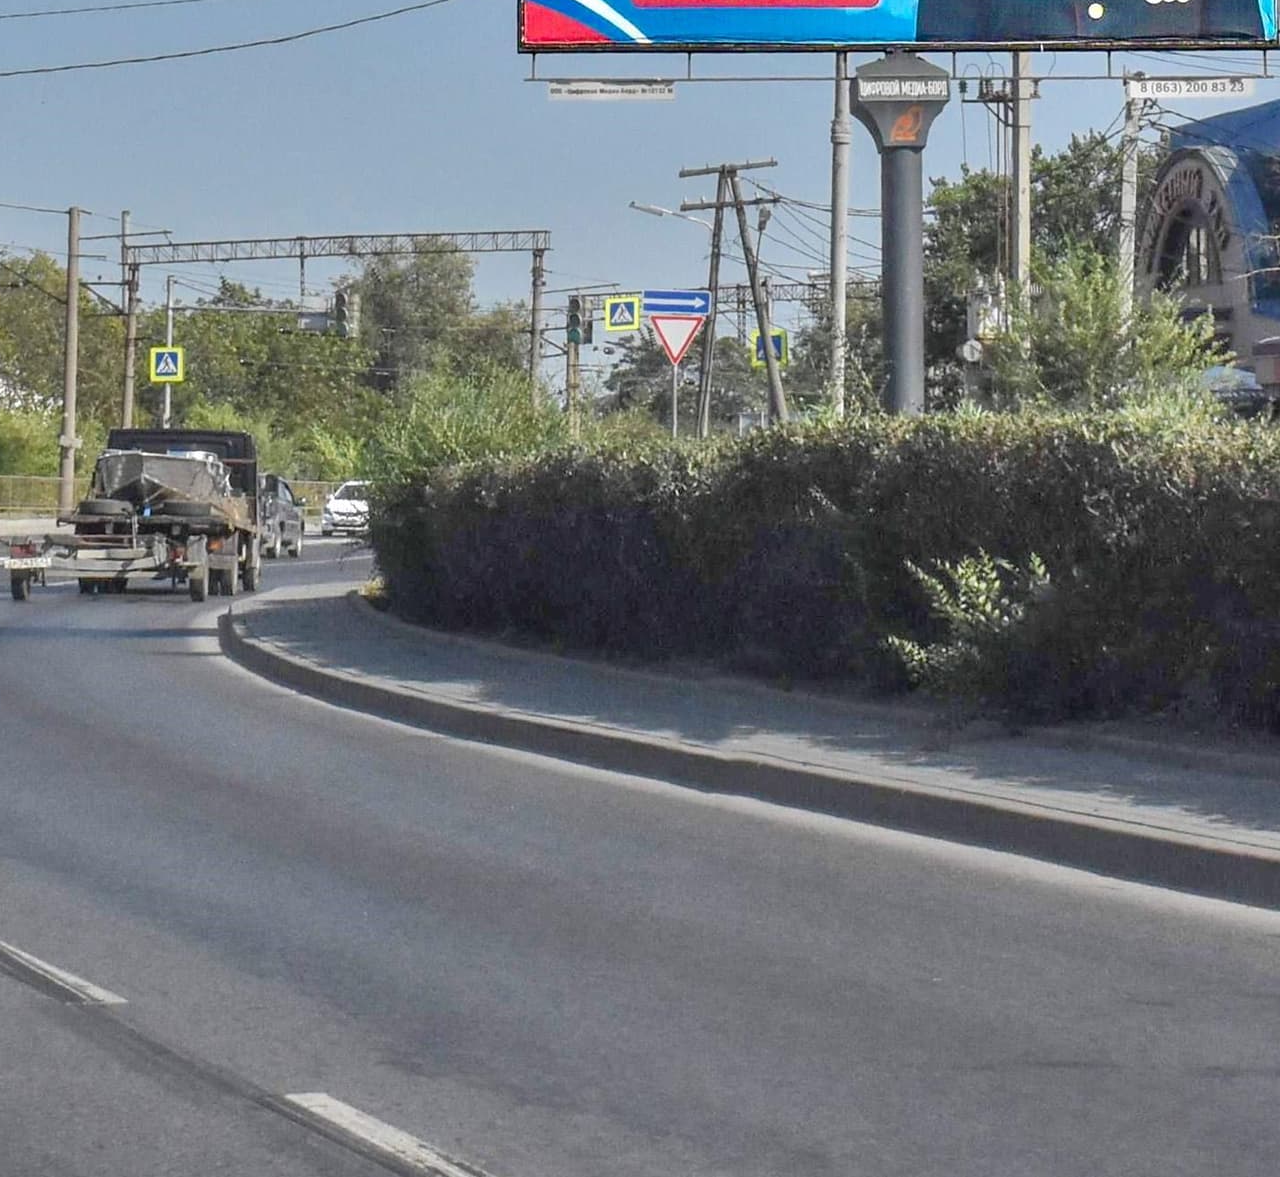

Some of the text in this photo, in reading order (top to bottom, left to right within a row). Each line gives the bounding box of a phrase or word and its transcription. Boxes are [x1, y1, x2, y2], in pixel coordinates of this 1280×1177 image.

[901, 80, 948, 97] МЕДИА-БОРД
[1140, 82, 1245, 95] 8 (863) 200 83 23
